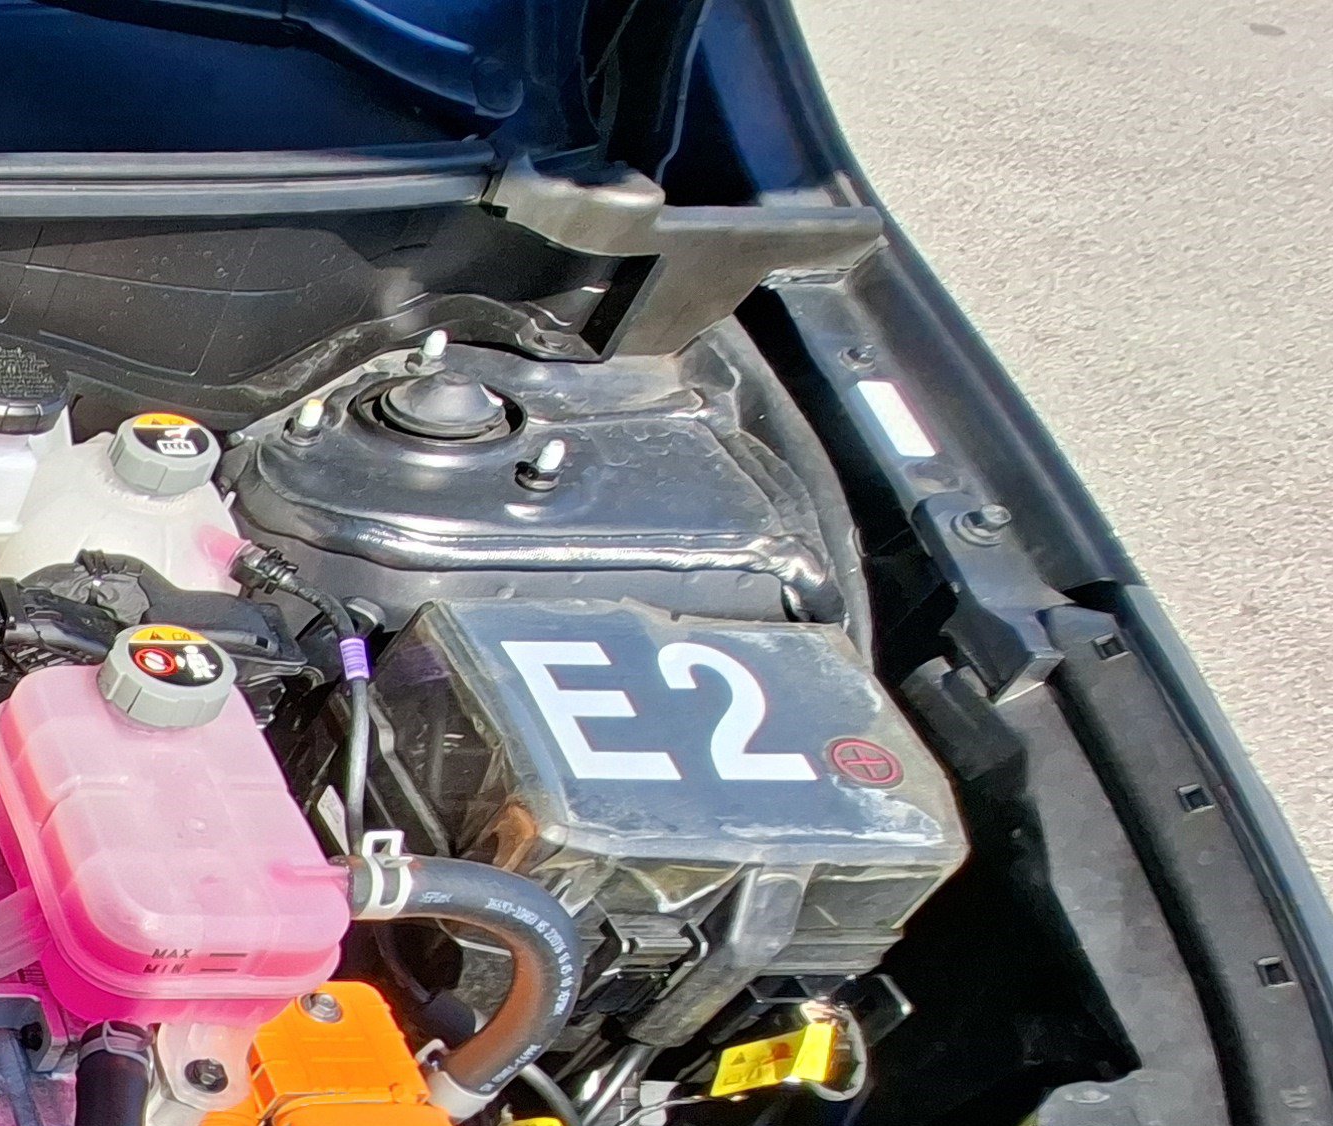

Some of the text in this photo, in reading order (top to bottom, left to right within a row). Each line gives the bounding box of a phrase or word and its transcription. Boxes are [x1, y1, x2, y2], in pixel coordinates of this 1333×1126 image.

[500, 641, 819, 780] E2
[152, 948, 193, 959] MAX
[143, 963, 185, 974] MIN
